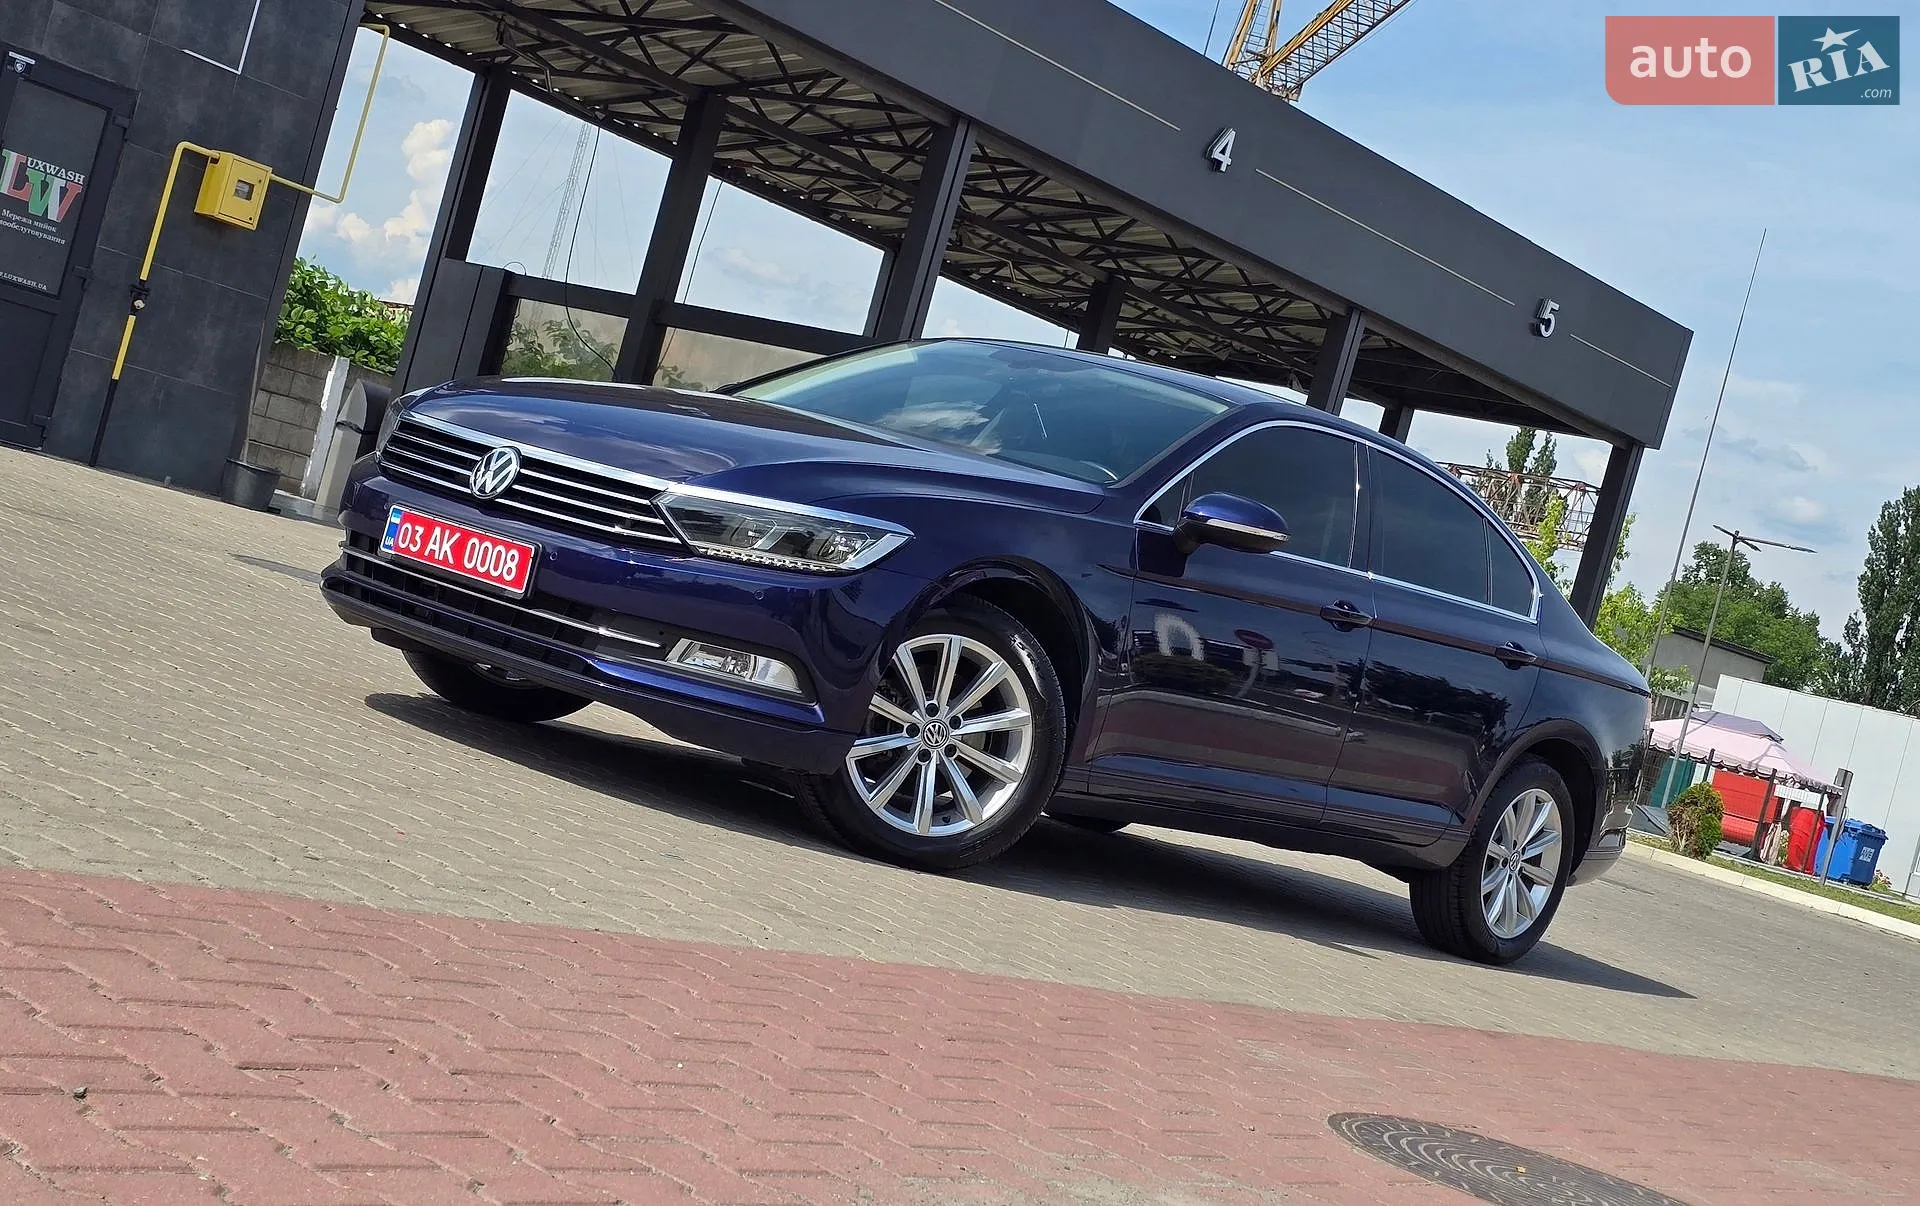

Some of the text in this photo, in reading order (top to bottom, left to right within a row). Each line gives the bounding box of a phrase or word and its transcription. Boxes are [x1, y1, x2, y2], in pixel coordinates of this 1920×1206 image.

[1210, 128, 1236, 172] 4
[1, 208, 57, 233] Мережа мийок
[1538, 299, 1560, 338] 5
[384, 535, 394, 547] UA
[398, 522, 520, 582] 03 AK 0008
